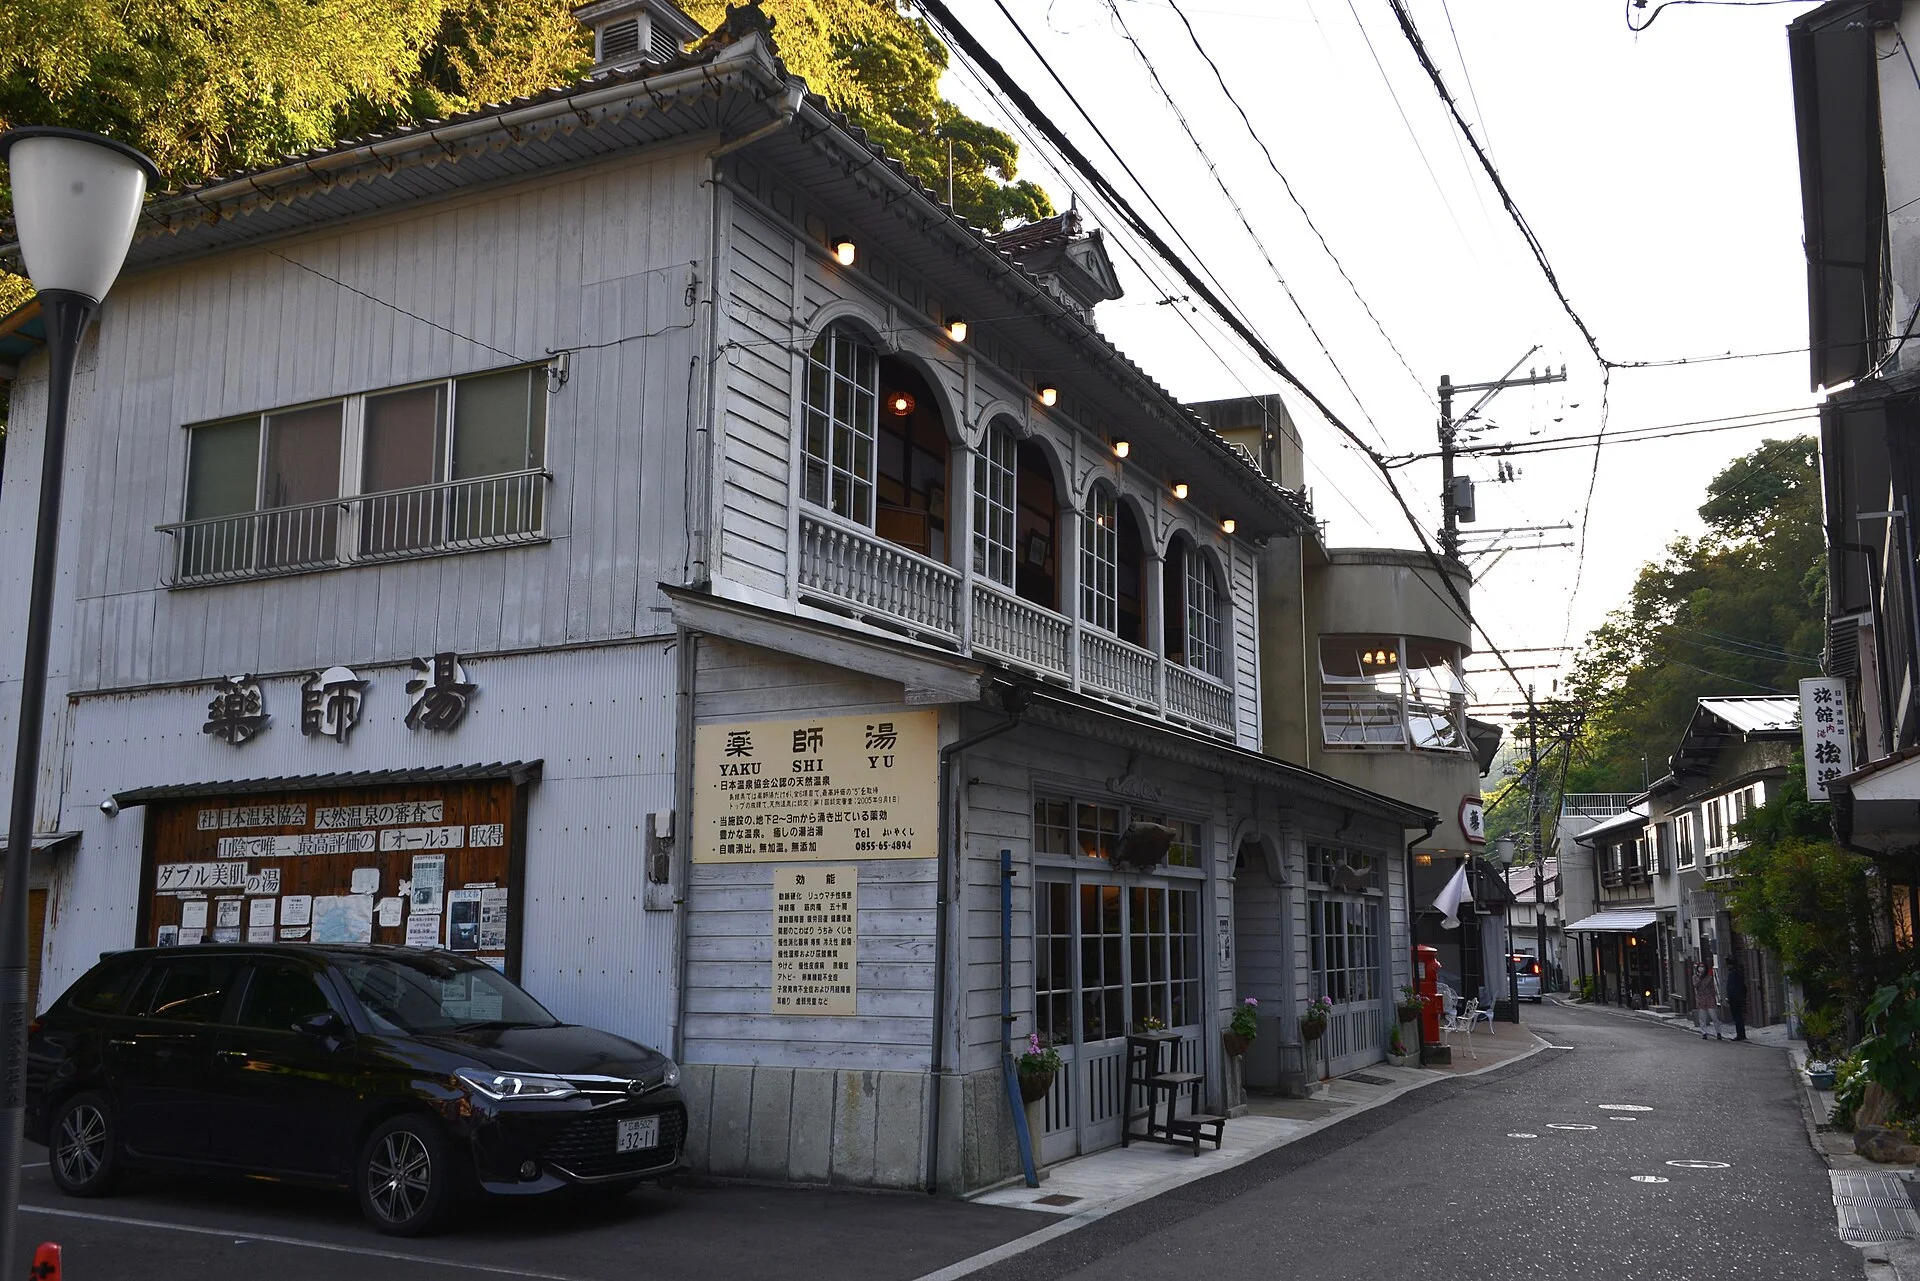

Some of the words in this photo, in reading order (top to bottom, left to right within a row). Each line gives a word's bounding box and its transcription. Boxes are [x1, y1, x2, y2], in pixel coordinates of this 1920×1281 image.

[1813, 687, 1834, 723] 旅館
[719, 762, 762, 777] YAKU
[792, 759, 824, 773] SHI
[868, 755, 895, 769] YU
[316, 802, 442, 828] 天然温泉の審査で
[470, 824, 503, 847] 取得
[853, 827, 870, 838] Tel
[855, 840, 912, 851] 0855-65-4894
[160, 863, 279, 892] ダブル美肌の湯
[778, 904, 796, 912] 神経痛
[804, 903, 822, 912] 筋肉痛
[829, 902, 848, 911] 五十肩
[817, 926, 833, 935] うちみ
[836, 926, 852, 935] くじき
[777, 961, 793, 970] やけど
